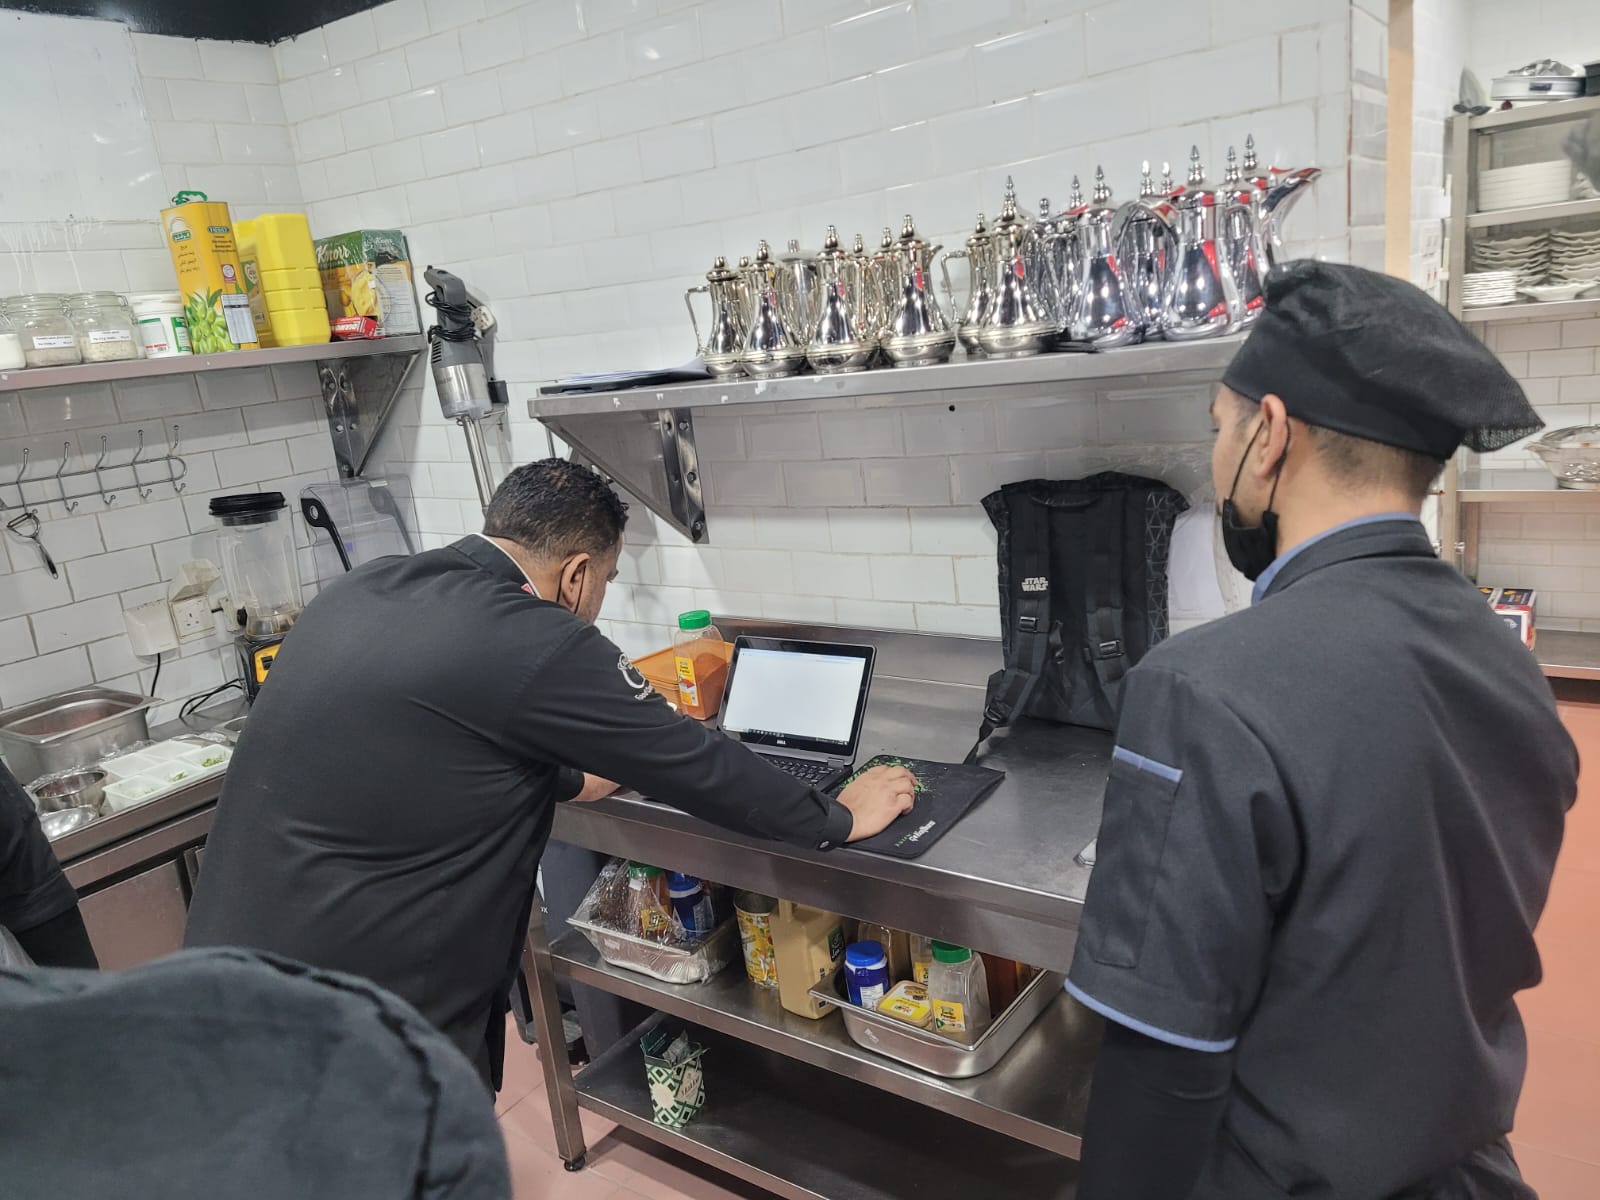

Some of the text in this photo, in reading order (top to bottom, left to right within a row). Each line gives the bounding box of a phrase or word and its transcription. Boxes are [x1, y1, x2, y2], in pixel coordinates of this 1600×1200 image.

[315, 243, 352, 264] Knorr
[1022, 576, 1048, 585] STAR
[1022, 583, 1048, 592] WARS
